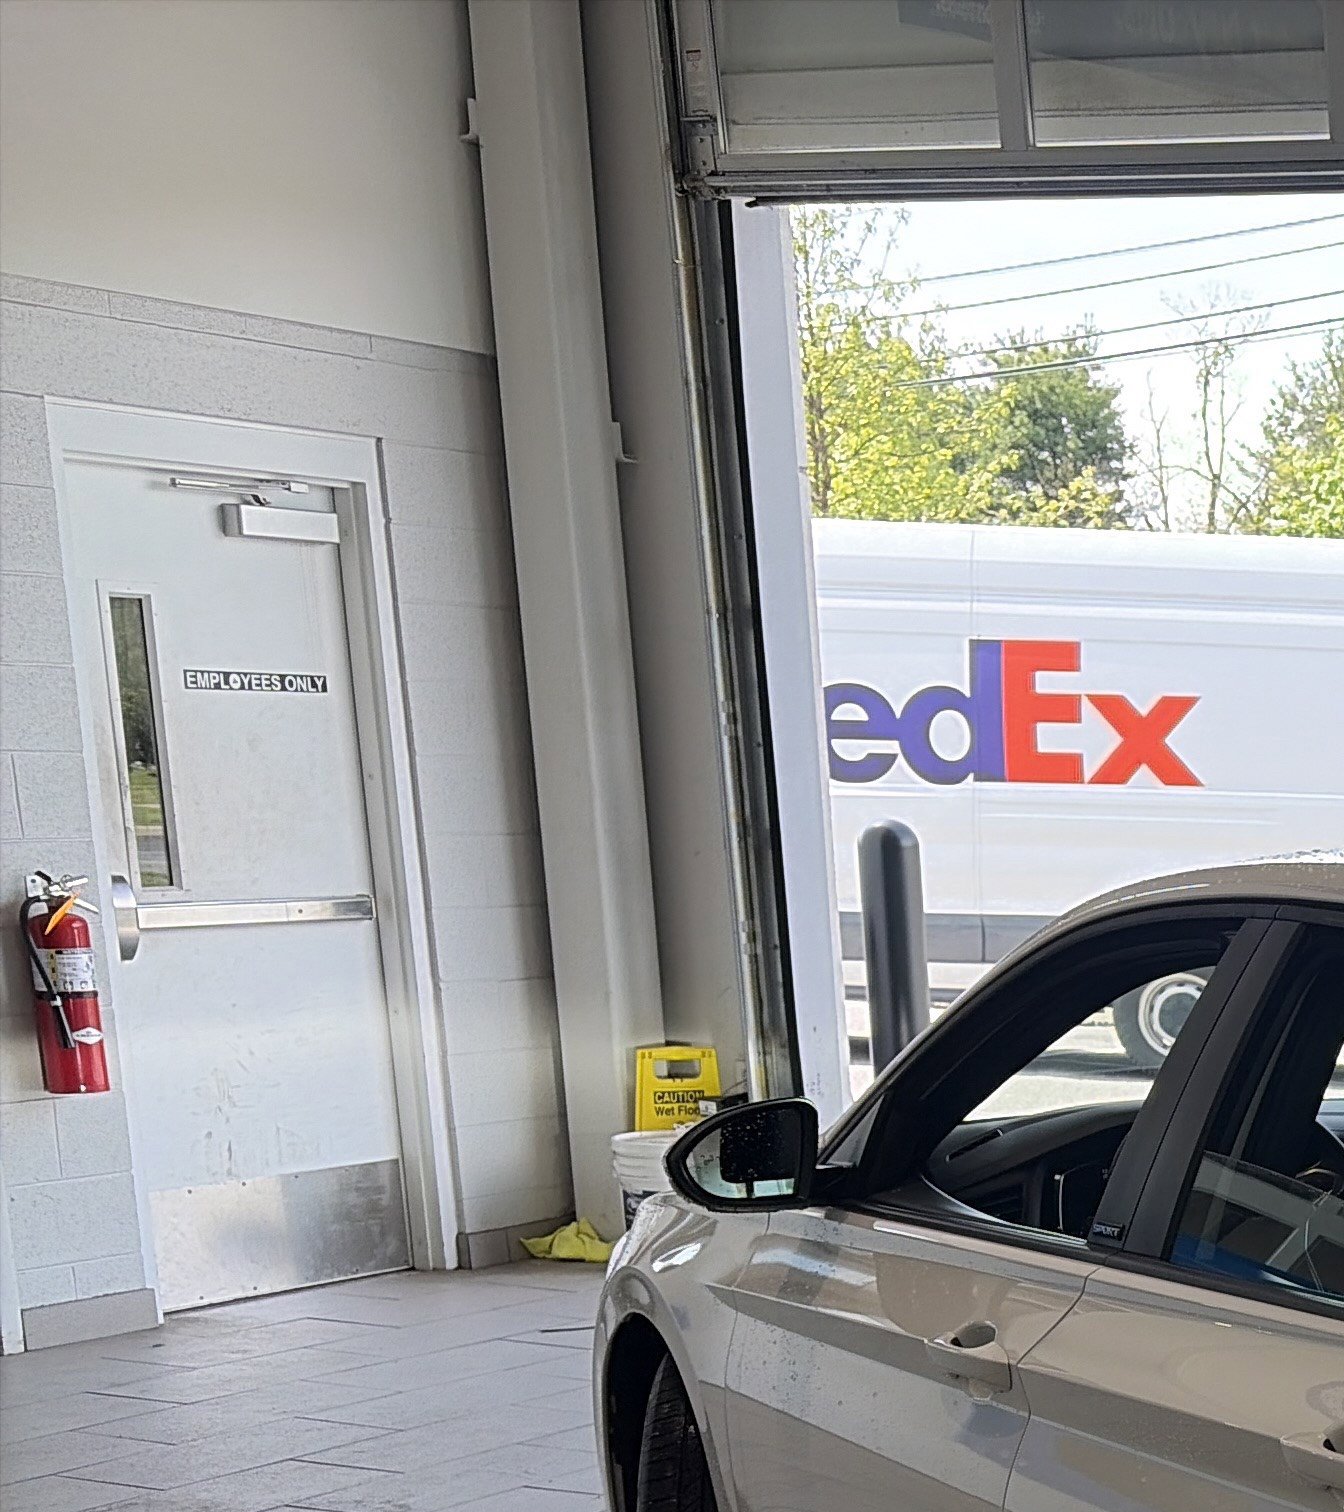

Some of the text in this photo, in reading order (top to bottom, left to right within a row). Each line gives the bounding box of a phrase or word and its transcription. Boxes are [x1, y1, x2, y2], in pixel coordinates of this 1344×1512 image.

[186, 671, 325, 692] EMPLOYEES ONLY
[823, 638, 1205, 787] edEx
[655, 1091, 704, 1104] CAUTION
[654, 1104, 701, 1117] Wet Floo
[1092, 1223, 1121, 1237] SPORT
